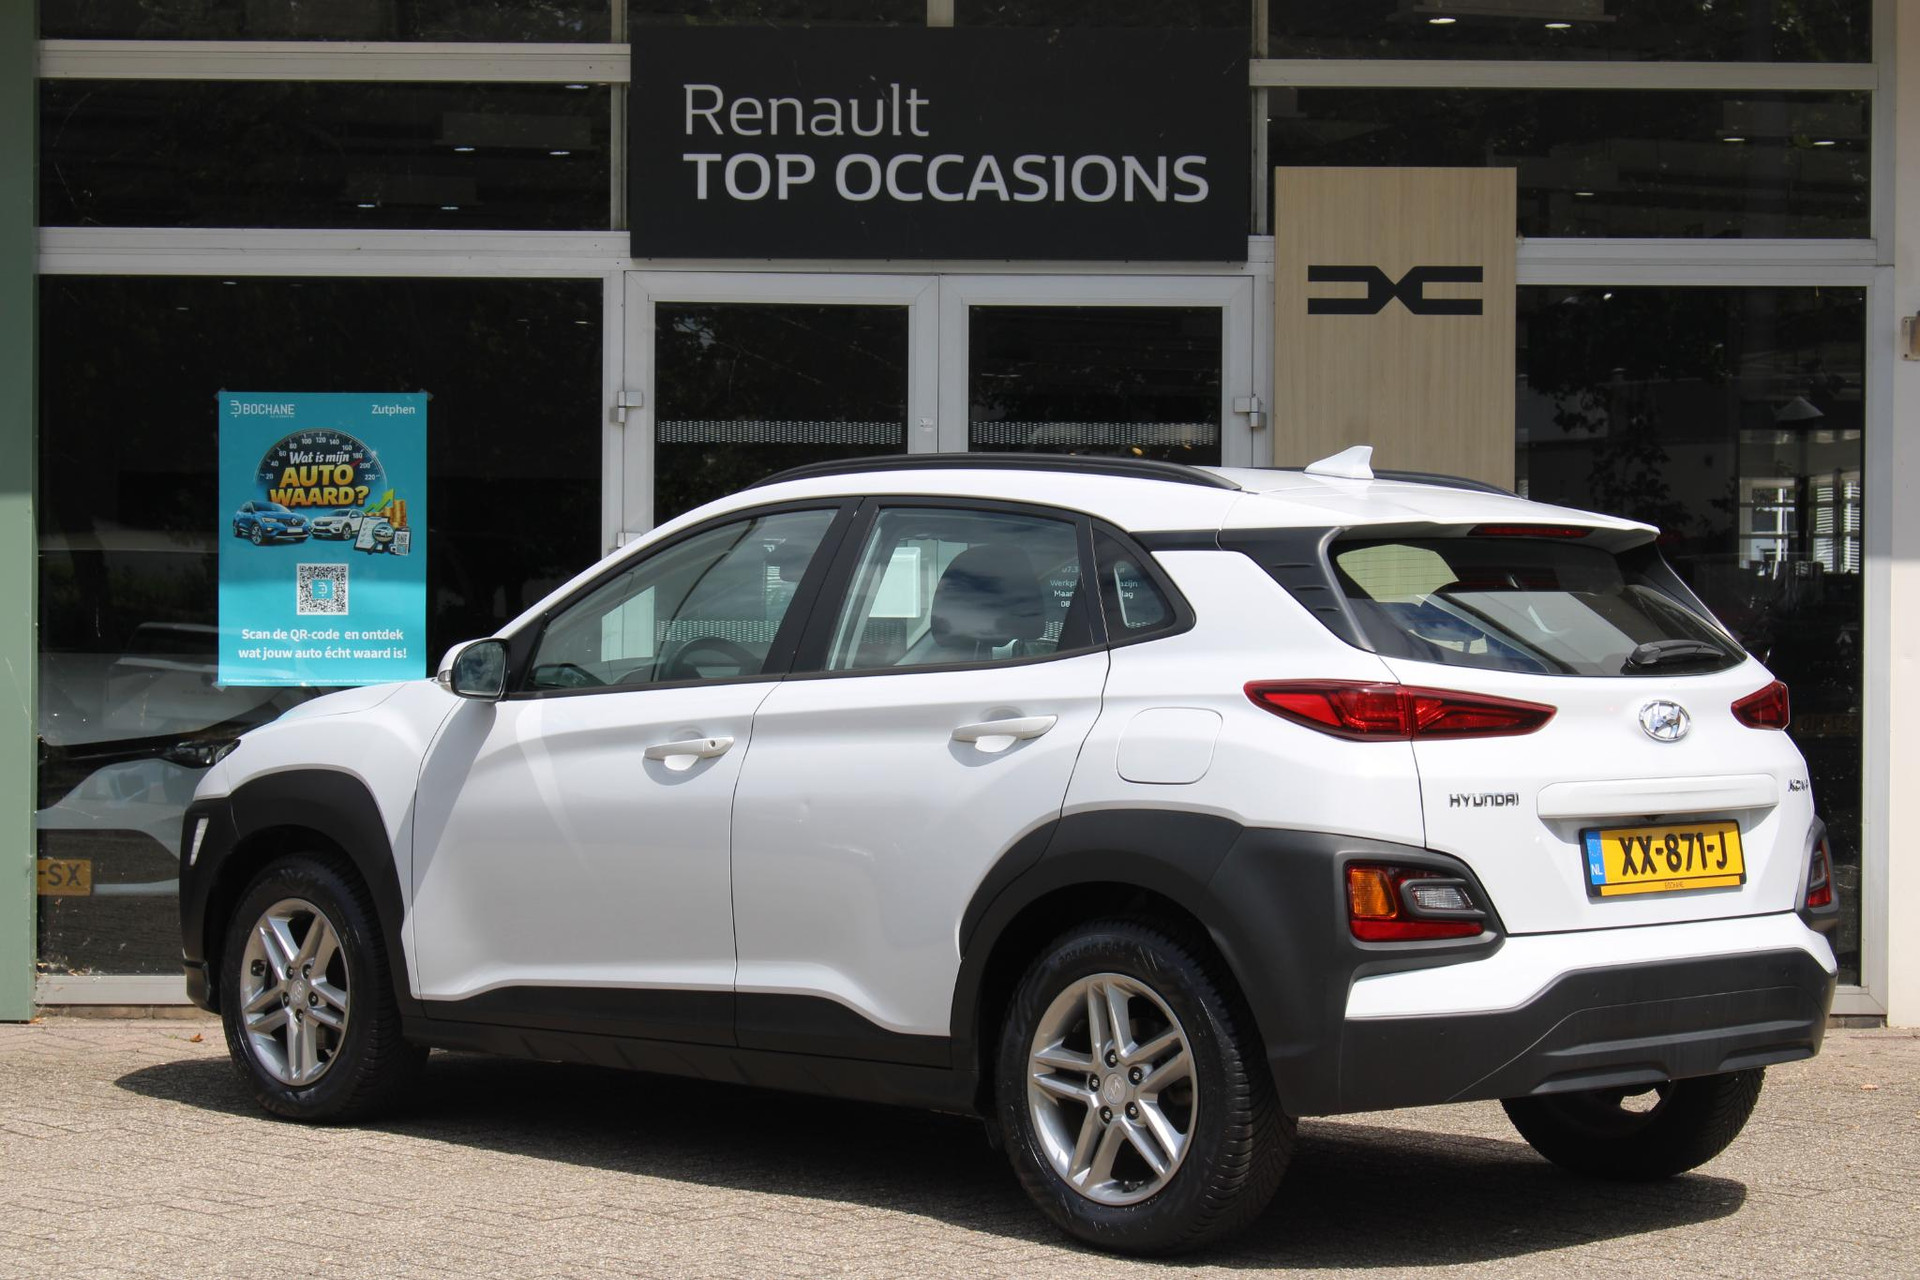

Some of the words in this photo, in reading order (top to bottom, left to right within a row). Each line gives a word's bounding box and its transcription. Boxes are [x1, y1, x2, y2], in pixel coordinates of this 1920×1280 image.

[683, 82, 930, 137] Renault
[682, 152, 816, 200] TOP
[834, 153, 1210, 203] OCCASIONS
[243, 403, 295, 415] BOCHANE
[371, 404, 416, 417] Zutphen
[289, 452, 313, 465] Wat
[315, 451, 324, 463] is
[325, 451, 350, 465] mijn
[279, 464, 354, 488] AUTO
[269, 485, 370, 507] WAARD?
[1050, 579, 1077, 588] Werkpl
[241, 629, 270, 640] Scan
[273, 628, 288, 640] de
[290, 628, 340, 642] QR-code
[344, 631, 359, 640] en
[361, 629, 404, 640] ontdek
[238, 648, 260, 659] wat
[262, 647, 292, 660] jouw
[295, 648, 322, 659] auto
[325, 646, 351, 659] écht
[353, 647, 391, 659] waard
[392, 647, 407, 659] is!
[1449, 792, 1520, 808] HYUNDAI
[1618, 831, 1728, 876] XX-871-J
[1591, 863, 1604, 876] NL
